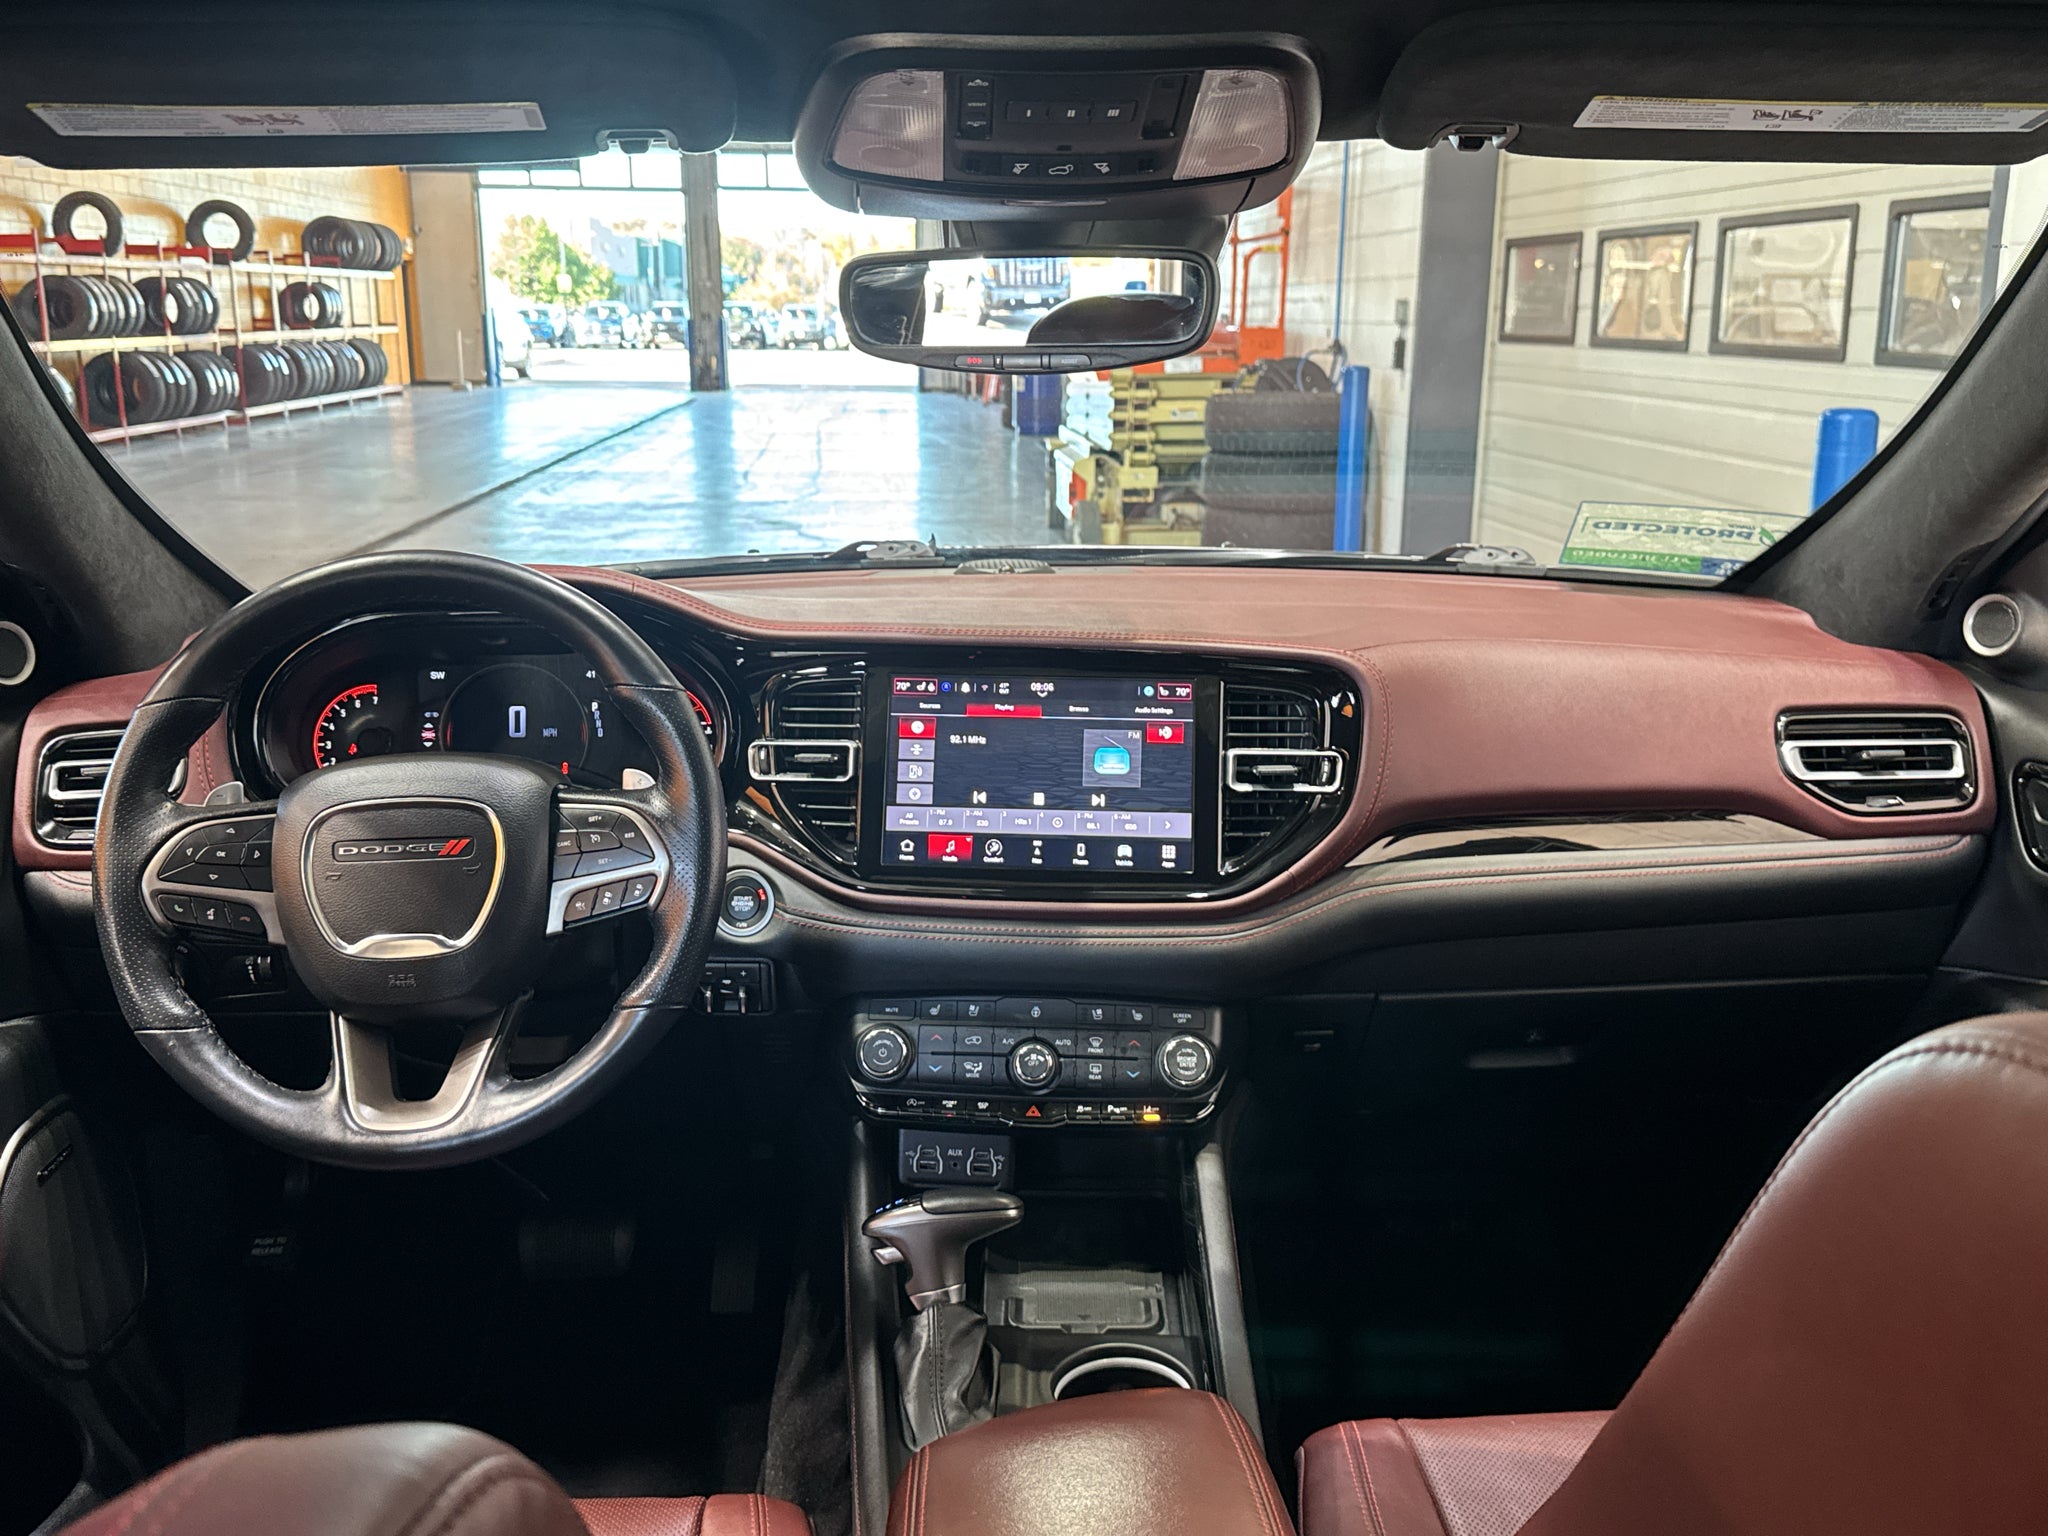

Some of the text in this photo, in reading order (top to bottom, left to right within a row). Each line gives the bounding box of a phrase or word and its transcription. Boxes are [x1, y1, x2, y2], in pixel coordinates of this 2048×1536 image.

[430, 671, 446, 680] SW
[586, 671, 596, 679] 41
[1030, 682, 1054, 692] 09:06
[354, 699, 361, 709] 6
[372, 696, 379, 705] 7
[340, 709, 346, 718] 5
[1134, 706, 1173, 715] Audio Settings
[508, 705, 527, 738] 0
[328, 722, 335, 731] 4
[542, 727, 558, 738] MPH
[1127, 731, 1140, 739] FM
[949, 734, 987, 744] 92.1 MHz
[324, 740, 332, 750] 3
[338, 843, 447, 856] DODGE
